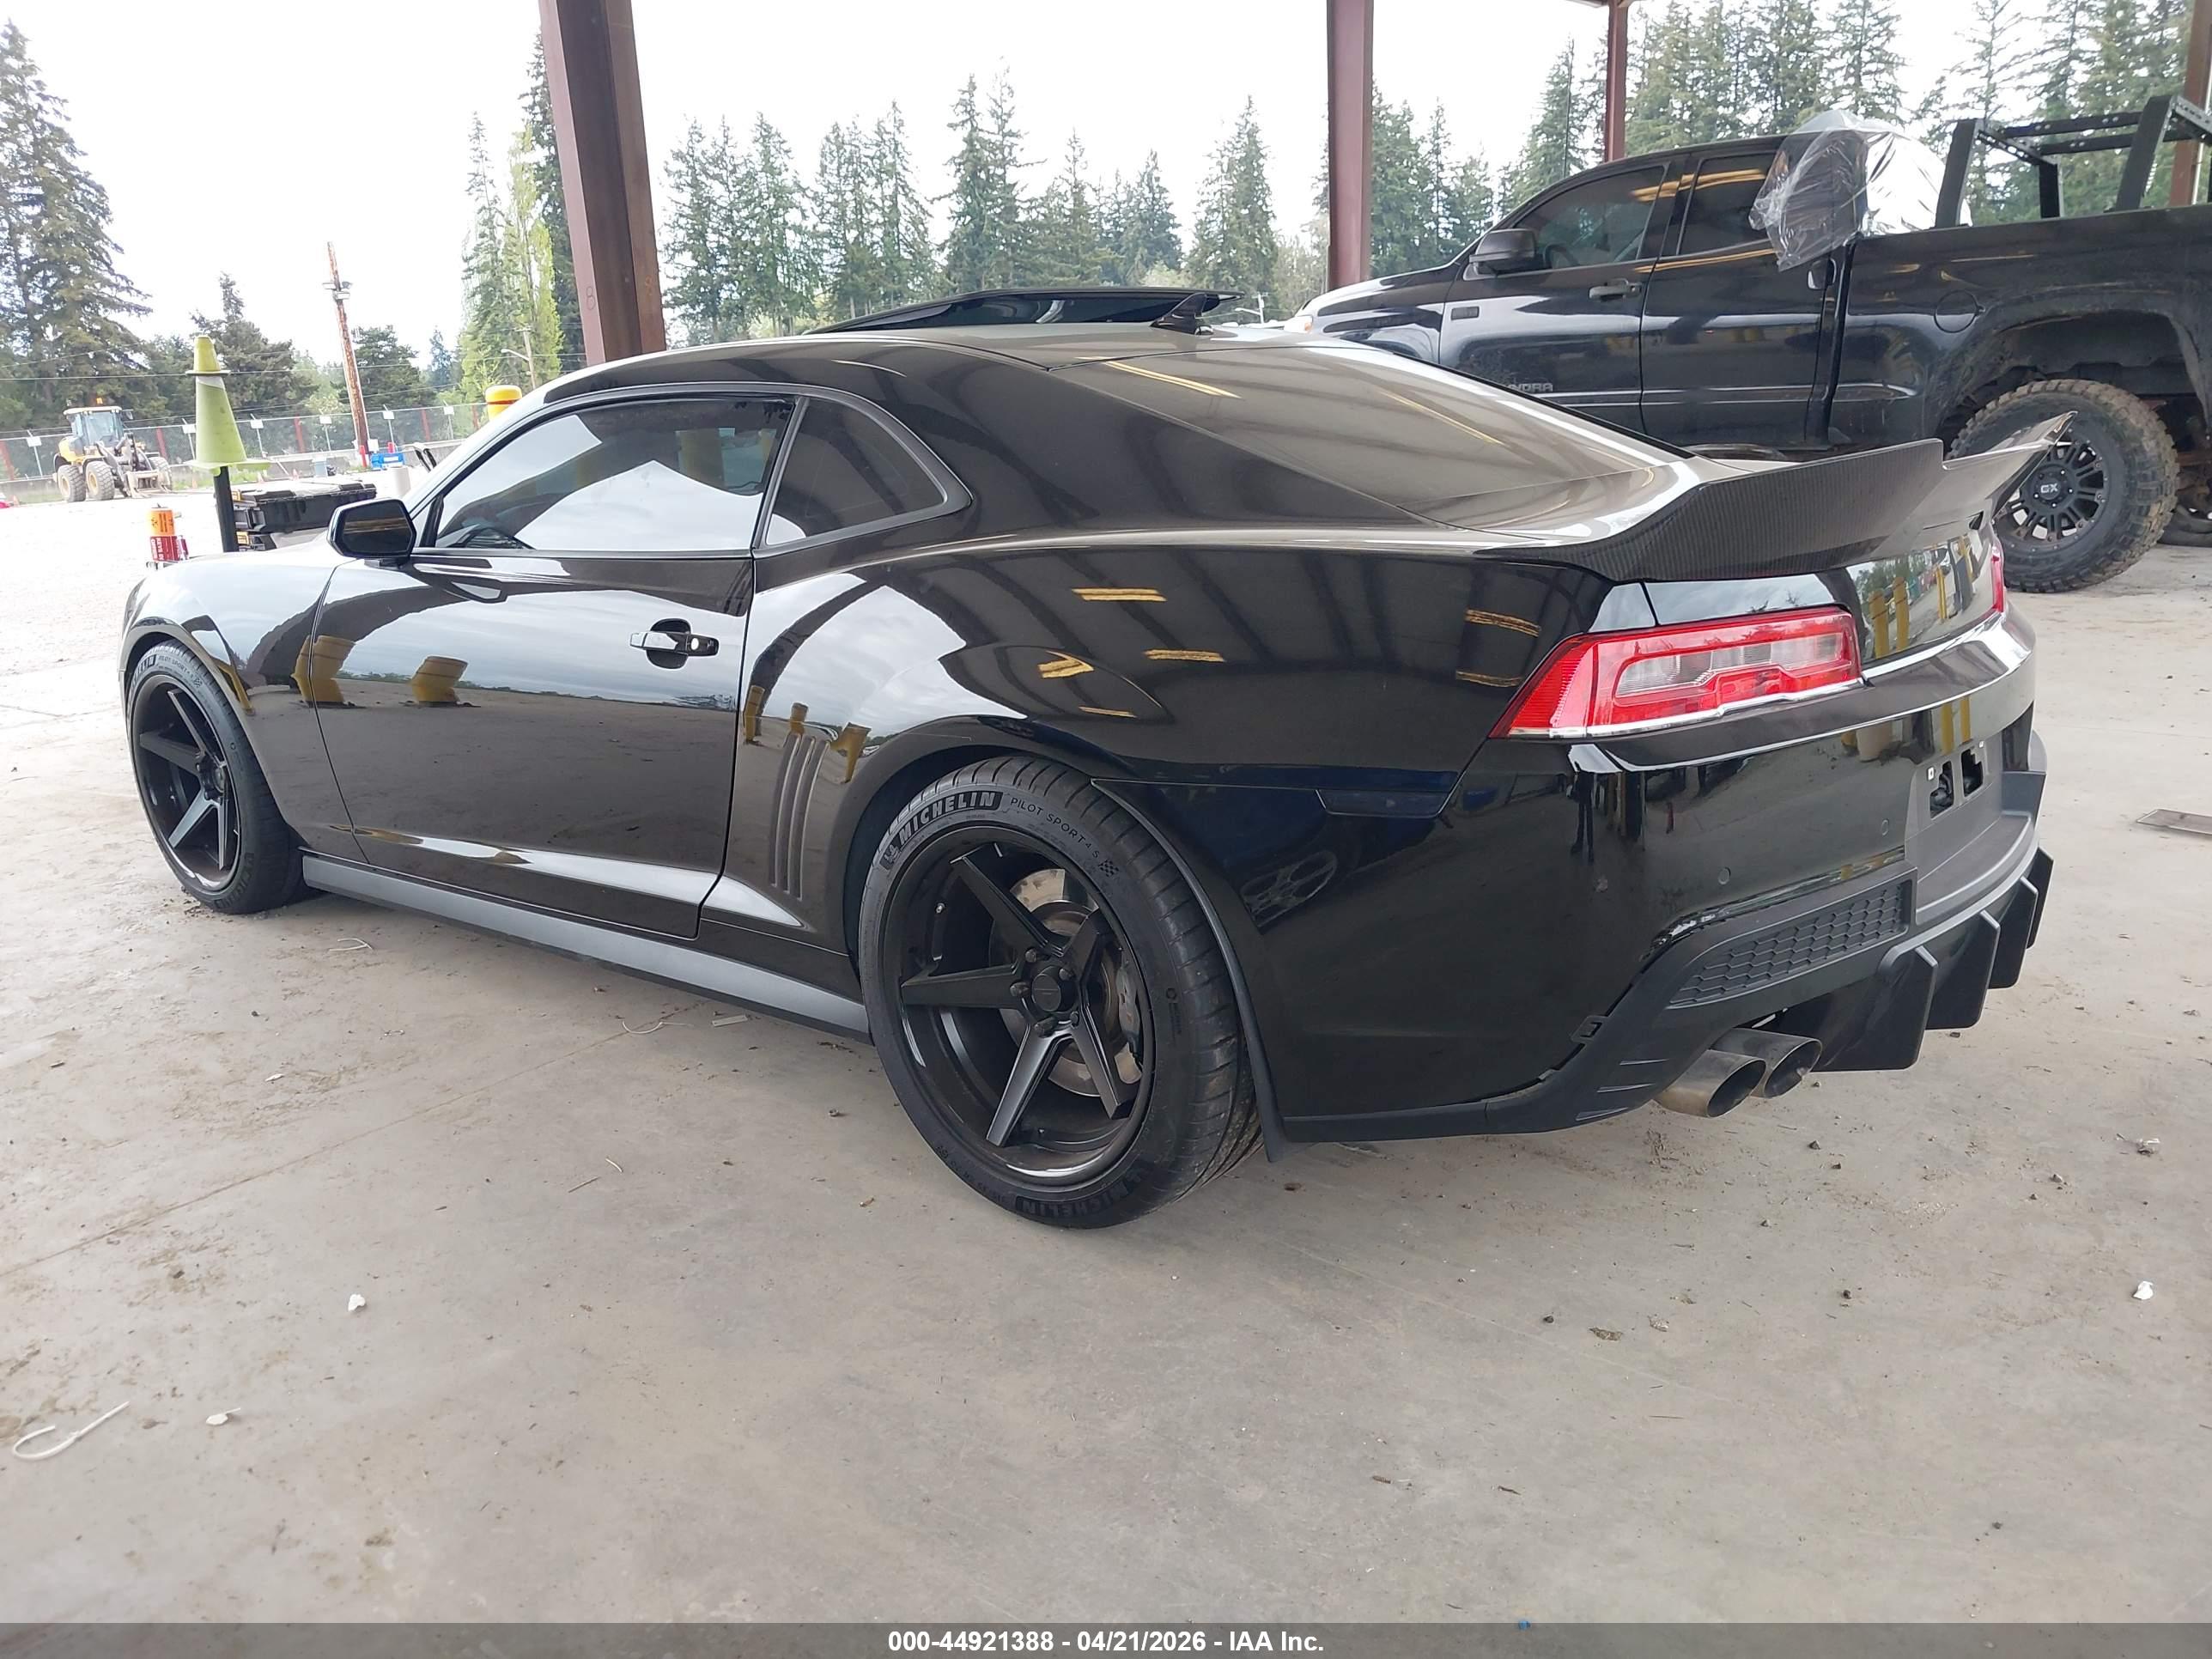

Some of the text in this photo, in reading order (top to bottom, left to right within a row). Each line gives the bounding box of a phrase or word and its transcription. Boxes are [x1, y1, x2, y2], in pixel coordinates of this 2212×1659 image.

[898, 792, 996, 844] MICHELIN
[1011, 797, 1044, 815] PILOT
[1047, 813, 1086, 843] SPORT
